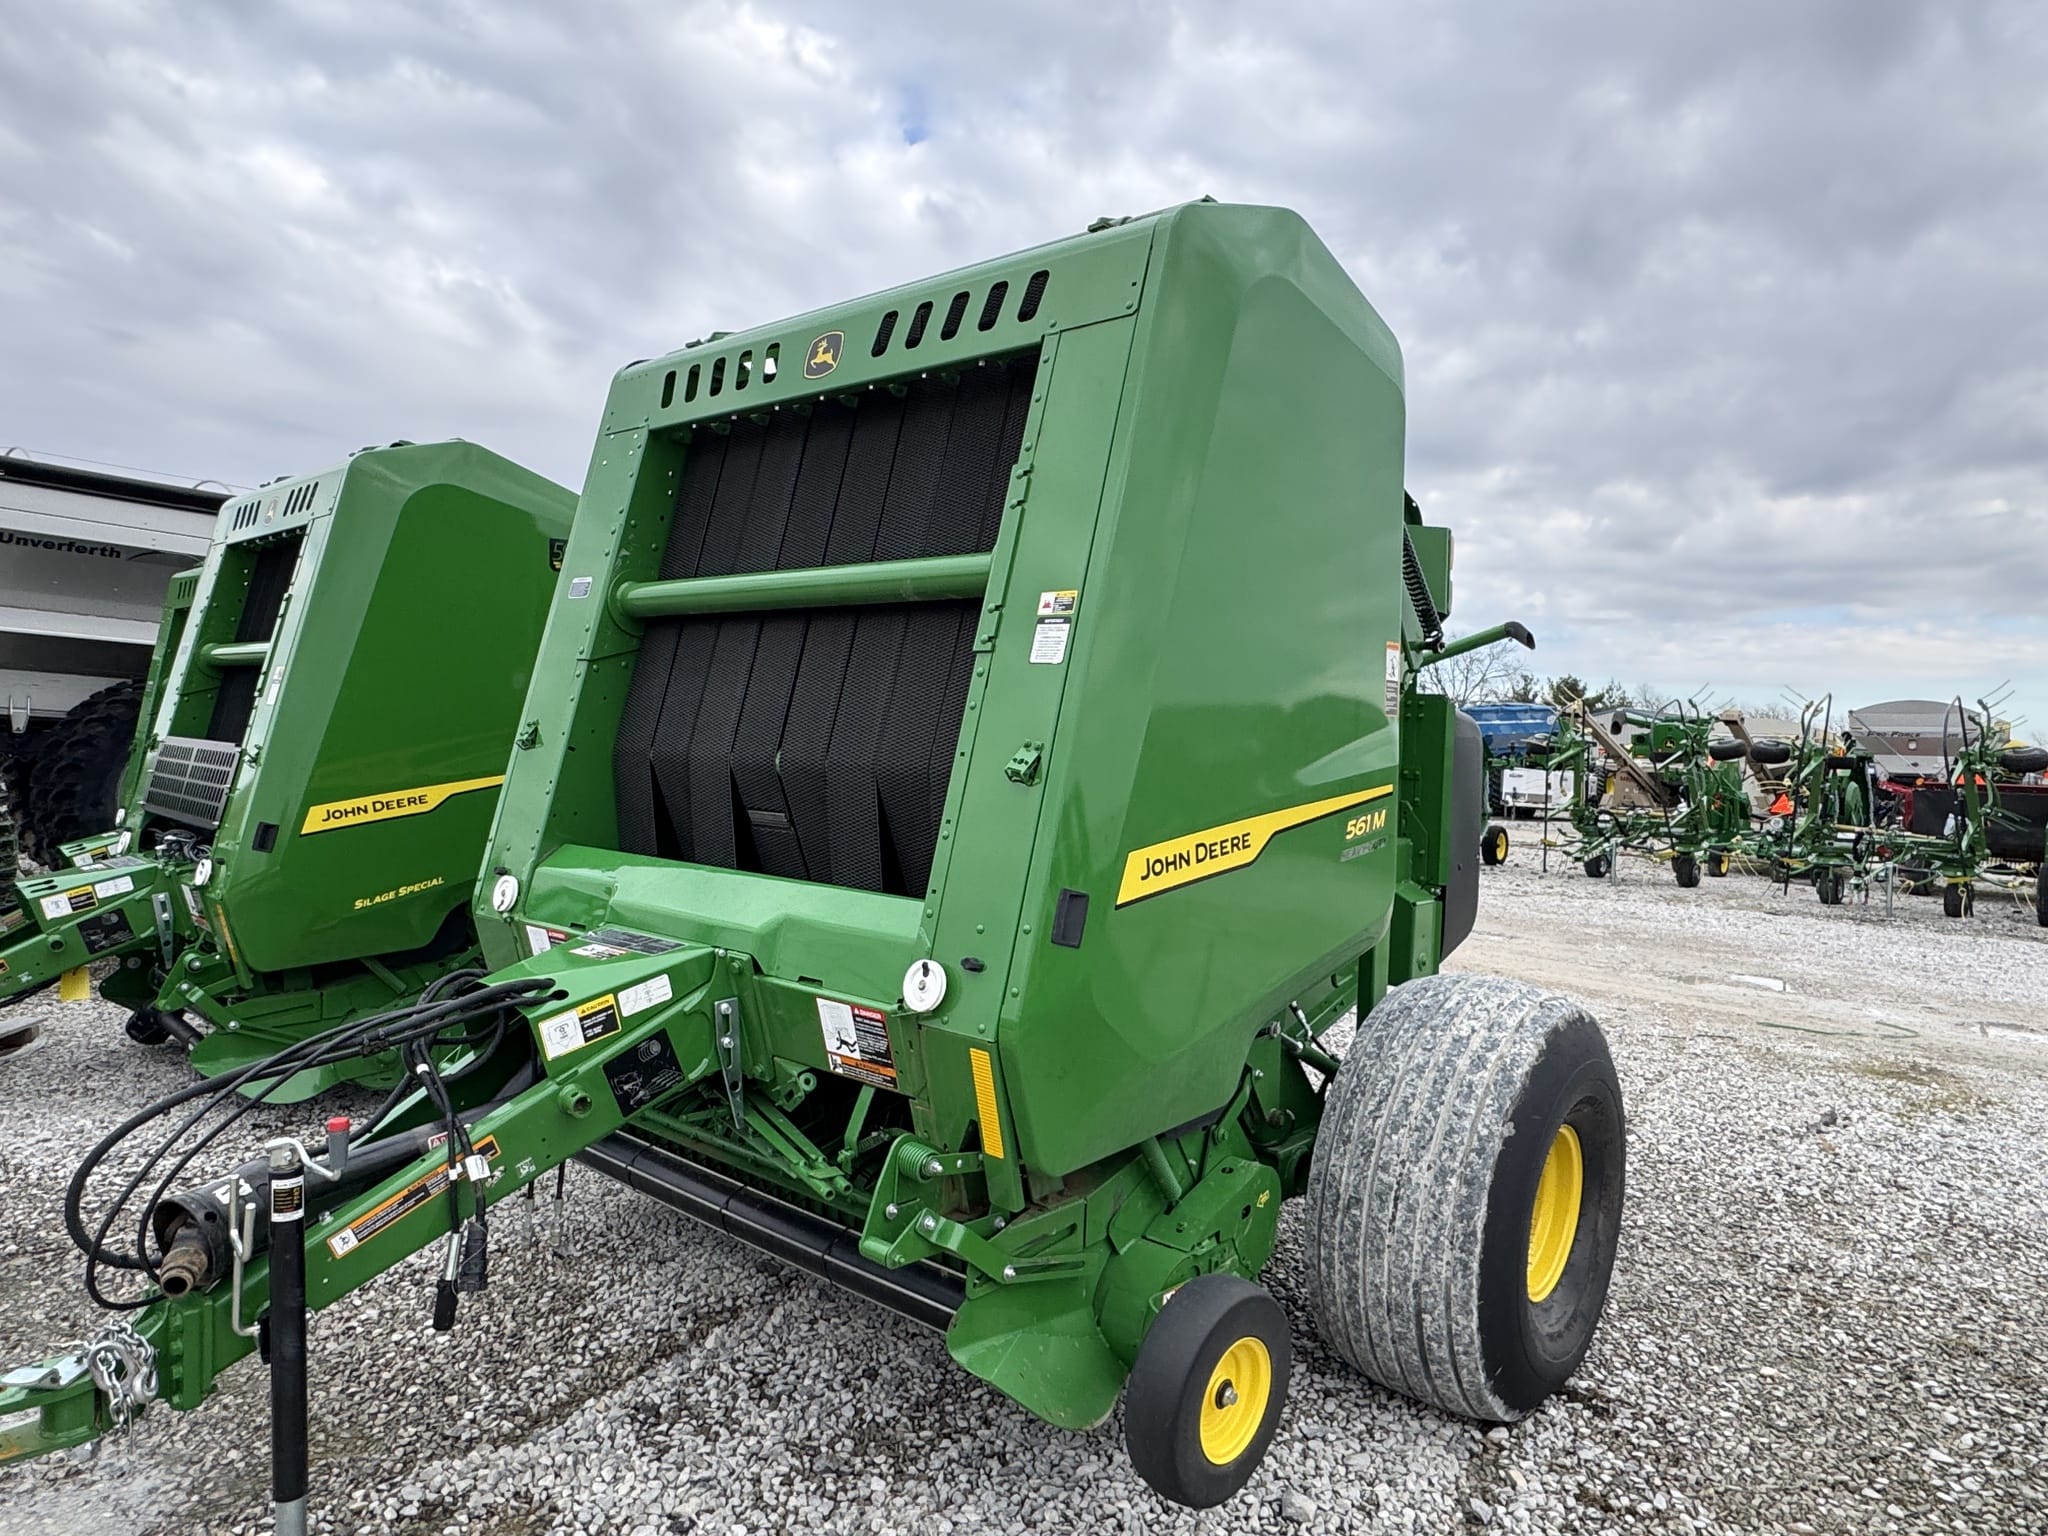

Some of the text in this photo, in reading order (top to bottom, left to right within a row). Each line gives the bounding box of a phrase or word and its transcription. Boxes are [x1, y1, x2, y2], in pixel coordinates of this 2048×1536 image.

[0, 531, 121, 559] Unverferth
[321, 794, 429, 822] JOHN DEERE
[1140, 832, 1252, 881] JOHN DEERE
[354, 876, 445, 910] SILAGE SPECIAL
